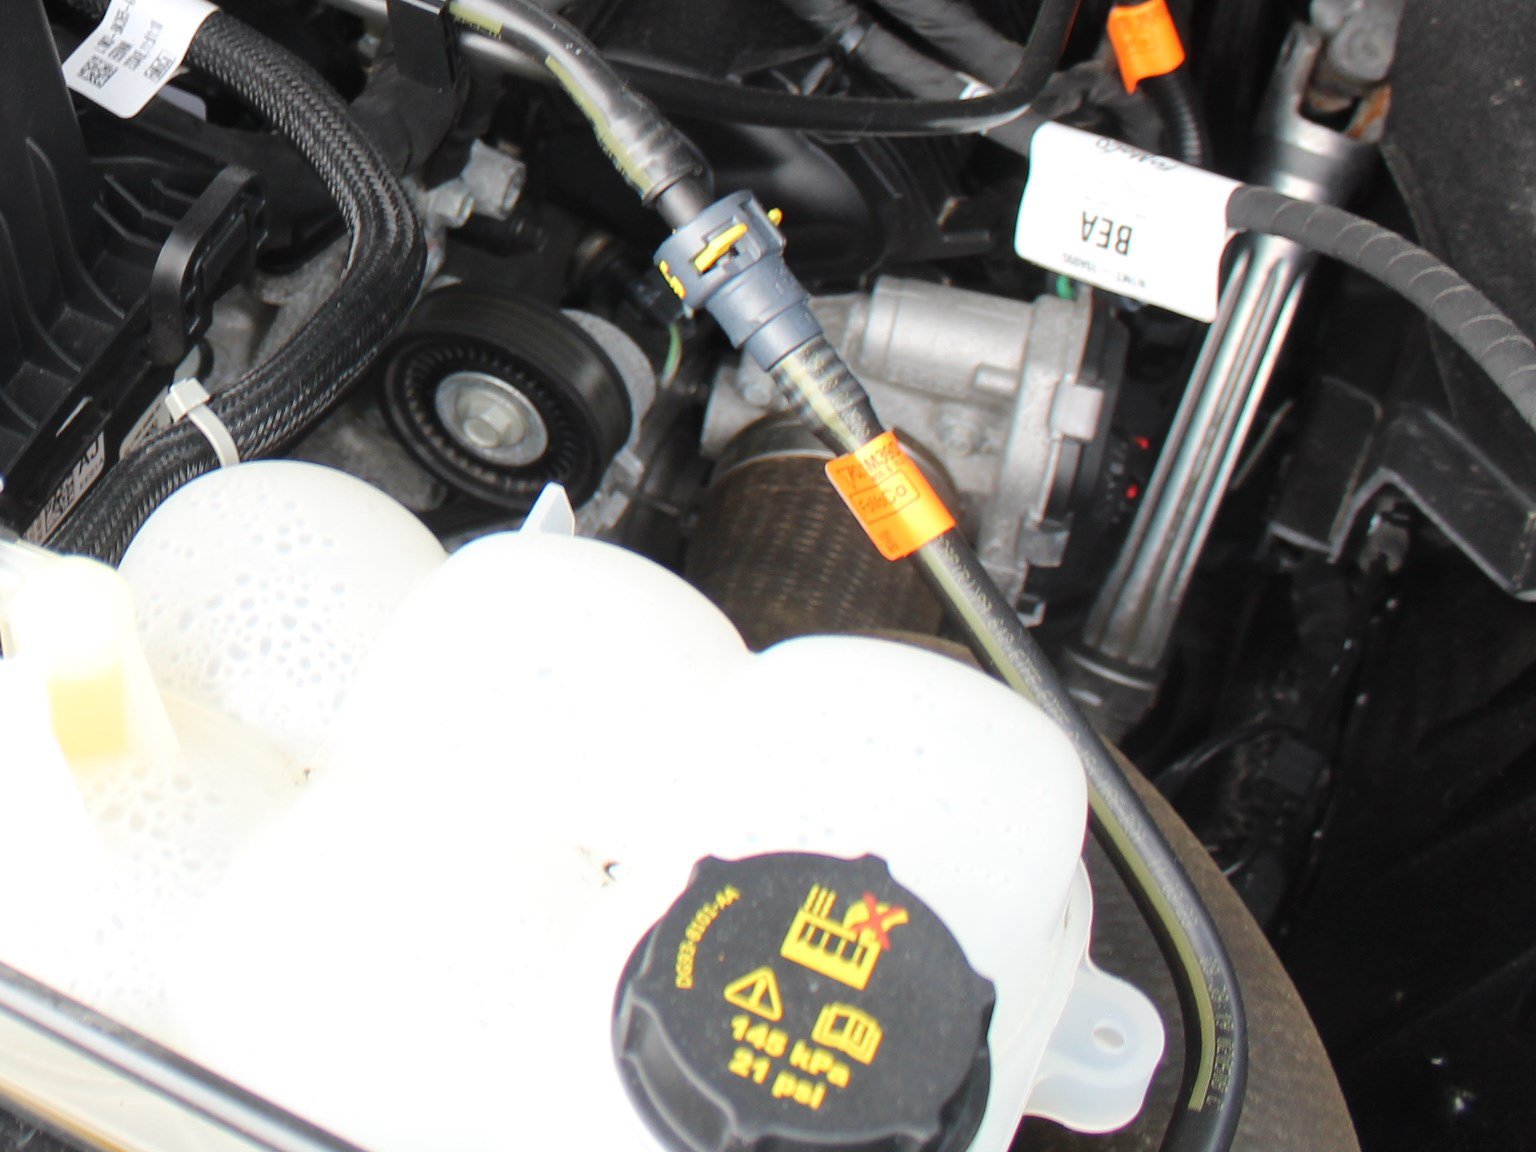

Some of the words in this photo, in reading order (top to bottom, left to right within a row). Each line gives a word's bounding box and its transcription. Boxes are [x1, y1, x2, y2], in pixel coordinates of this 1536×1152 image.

[1081, 210, 1133, 256] BEA
[727, 1048, 772, 1085] 21
[770, 1069, 828, 1110] psi
[788, 1039, 852, 1089] kPa
